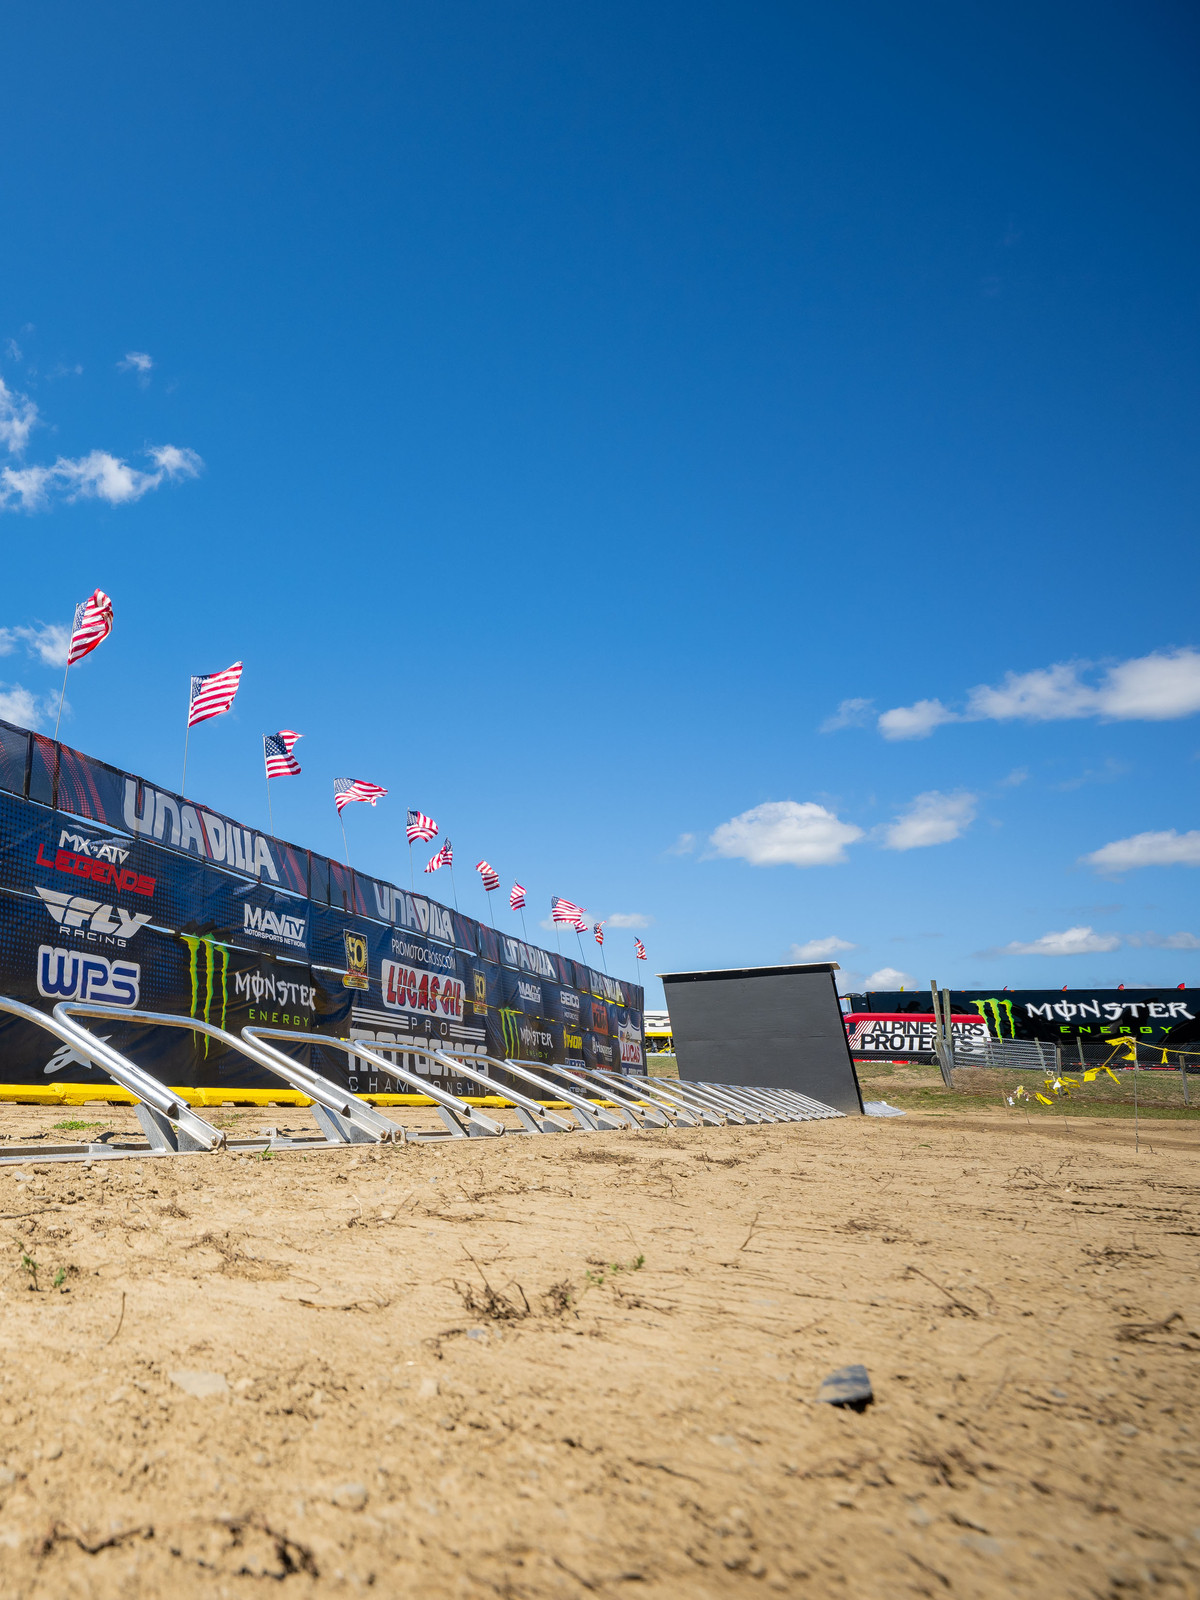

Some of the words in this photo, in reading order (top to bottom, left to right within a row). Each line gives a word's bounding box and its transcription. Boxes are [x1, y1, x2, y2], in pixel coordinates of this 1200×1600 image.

[123, 778, 280, 882] UNADILLA
[59, 830, 91, 856] MX
[96, 844, 130, 865] ATV
[36, 843, 156, 897] LEGENDS
[37, 886, 153, 939] FLY
[373, 882, 456, 944] UNADILLA
[59, 925, 127, 948] RACING
[244, 928, 283, 943] MOTORSPORTS
[284, 937, 306, 948] NETWORK
[348, 936, 365, 968] 50
[37, 944, 141, 1010] WPS
[235, 970, 316, 1011] MONSTER
[387, 965, 440, 1013] LUCAS
[443, 978, 462, 1017] OIL
[249, 1009, 309, 1027] ENERGY
[412, 1017, 448, 1035] PRO
[1025, 999, 1195, 1021] MONSTER
[563, 1026, 582, 1049] THOR
[871, 1021, 985, 1036] ALPINESARS
[1060, 1026, 1173, 1034] ENERGY
